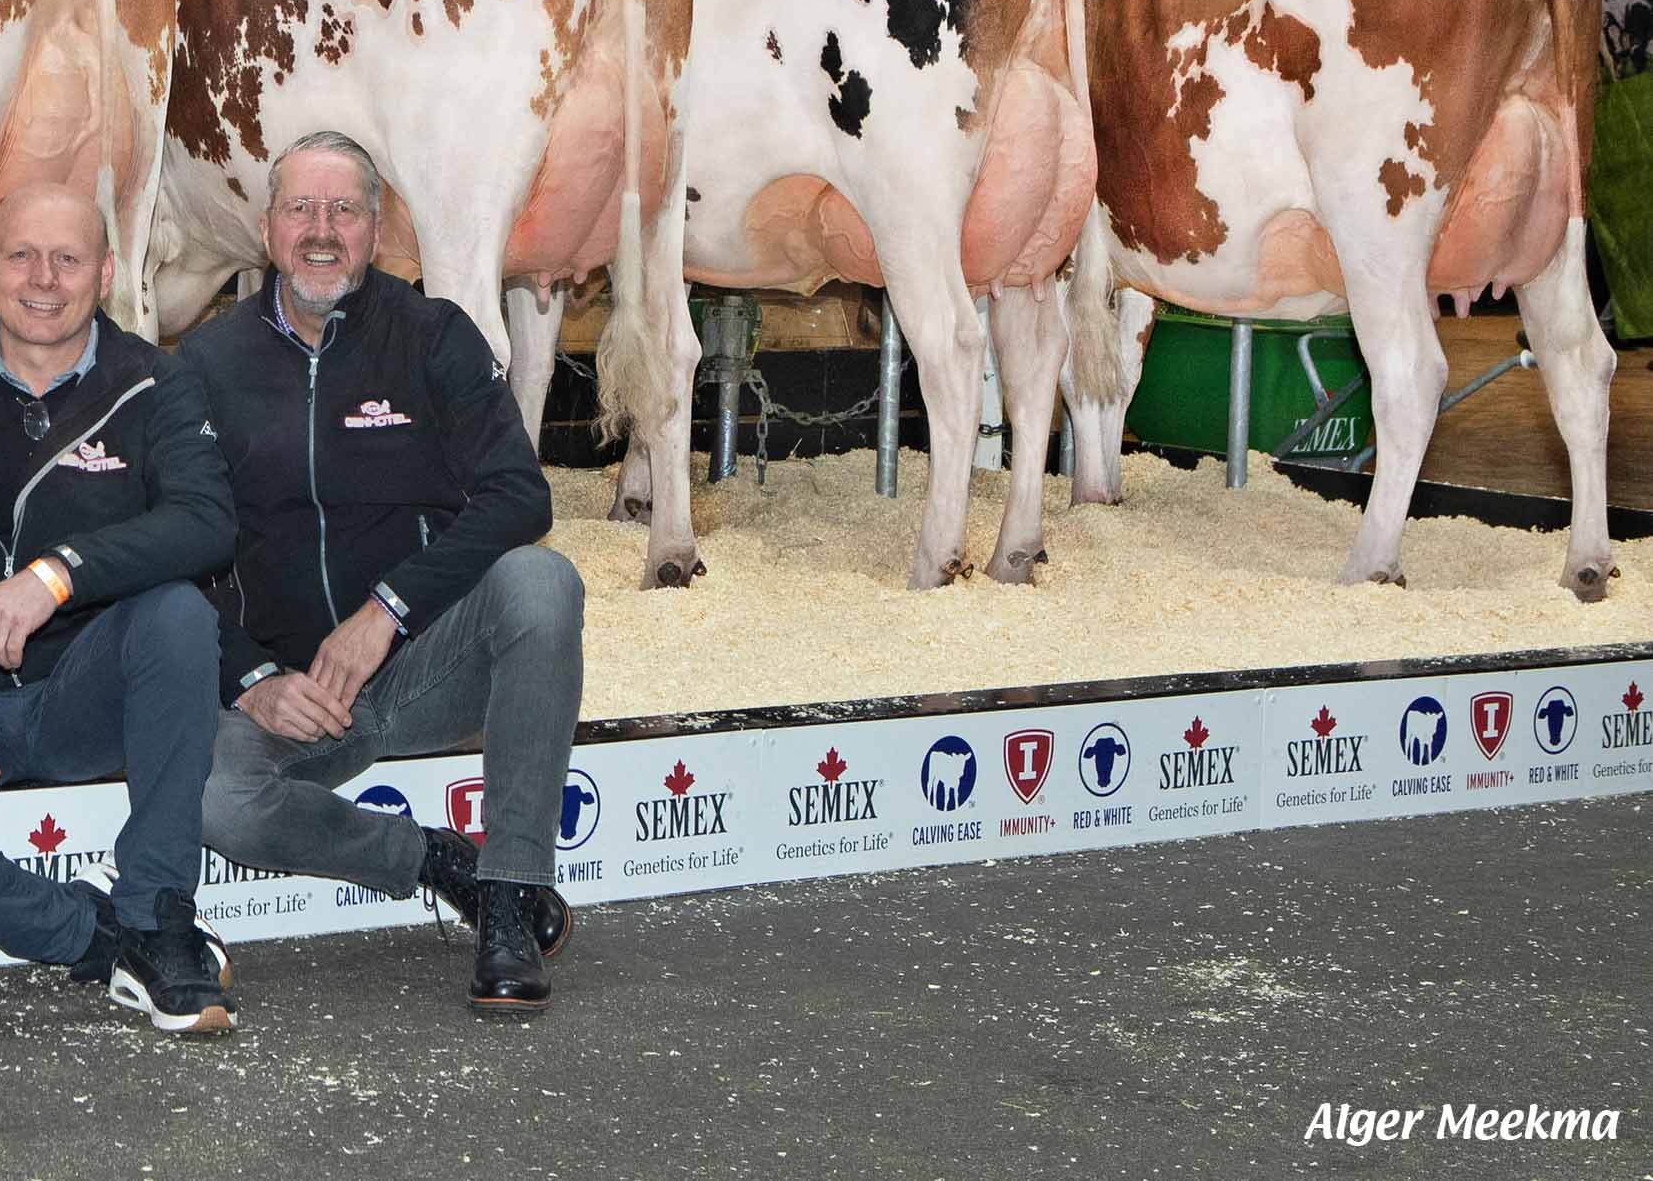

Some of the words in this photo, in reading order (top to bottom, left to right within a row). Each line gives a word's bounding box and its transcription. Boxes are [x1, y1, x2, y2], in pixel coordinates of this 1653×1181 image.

[1602, 711, 1653, 749] SEME
[1160, 747, 1234, 790] SEMEX
[1287, 735, 1363, 777] SEMEX
[1593, 761, 1635, 778] Genetics
[1639, 758, 1653, 774] for
[1392, 777, 1428, 797] CALVING
[1431, 775, 1451, 793] EASE
[1467, 770, 1514, 790] IMMUNITY+
[1530, 766, 1544, 784] RED
[1547, 766, 1552, 781] &
[1555, 763, 1578, 780] WHITE
[788, 780, 878, 826] SEMEX
[1276, 788, 1326, 808] Genetics
[1330, 785, 1346, 802] for
[1350, 781, 1372, 800] Life
[636, 793, 727, 842] SEMEX
[1074, 811, 1091, 829] RED
[1094, 810, 1100, 827] &
[1104, 807, 1132, 825] WHITE
[1148, 803, 1198, 821] Genetics
[1202, 800, 1218, 815] for
[1222, 796, 1243, 813] Life
[913, 824, 954, 846] CALVING
[958, 821, 981, 841] EASE
[1000, 815, 1056, 837] IMMUNITY+
[776, 839, 835, 860] Genetics
[839, 837, 859, 853] for
[863, 832, 888, 850] Life
[558, 864, 565, 883] &
[569, 860, 602, 882] WHITE
[623, 856, 683, 877] Genetics
[689, 853, 708, 870] for
[713, 848, 739, 866] Life
[247, 899, 270, 916] for
[276, 894, 306, 914] Life
